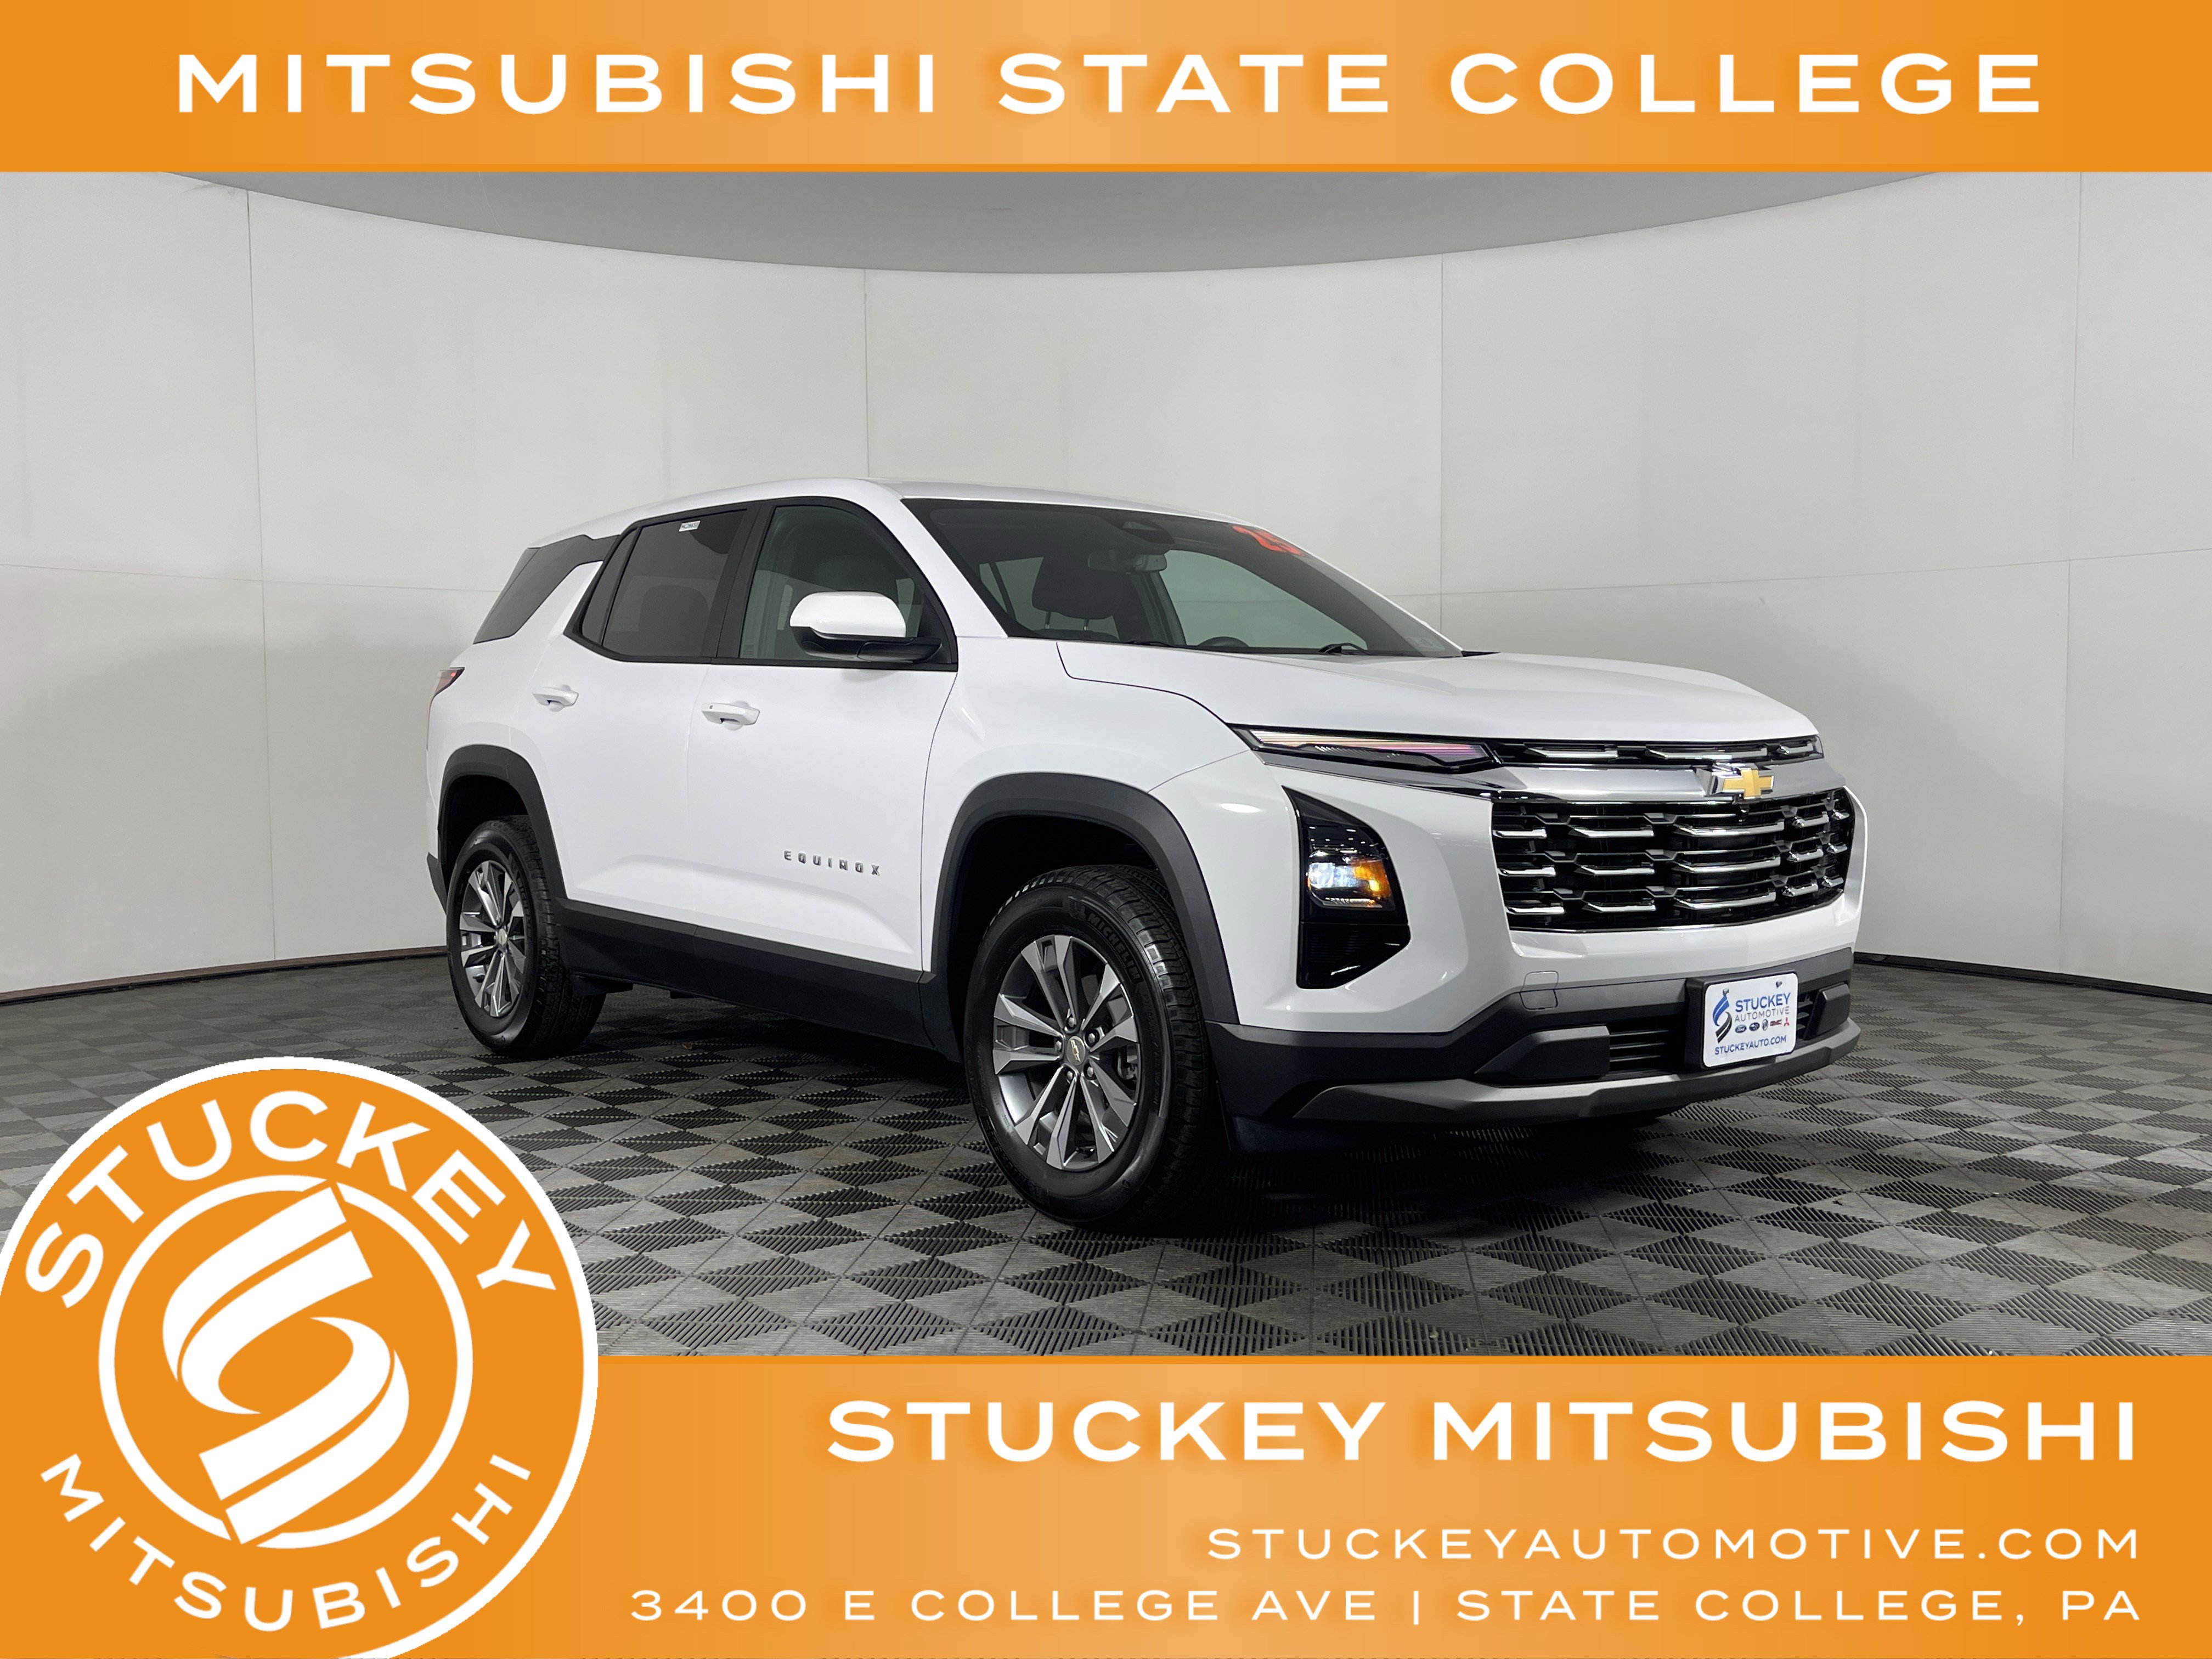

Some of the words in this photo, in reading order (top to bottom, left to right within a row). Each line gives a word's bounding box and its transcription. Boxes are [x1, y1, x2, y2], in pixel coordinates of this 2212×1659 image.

[784, 850, 881, 876] EQUINOX
[1087, 912, 1142, 980] MICHELIN
[1735, 992, 1791, 1013] STUCKEY
[1734, 1006, 1790, 1022] AUTOMOTIVE
[1714, 1035, 1787, 1055] STUCKEYAUTO.COM
